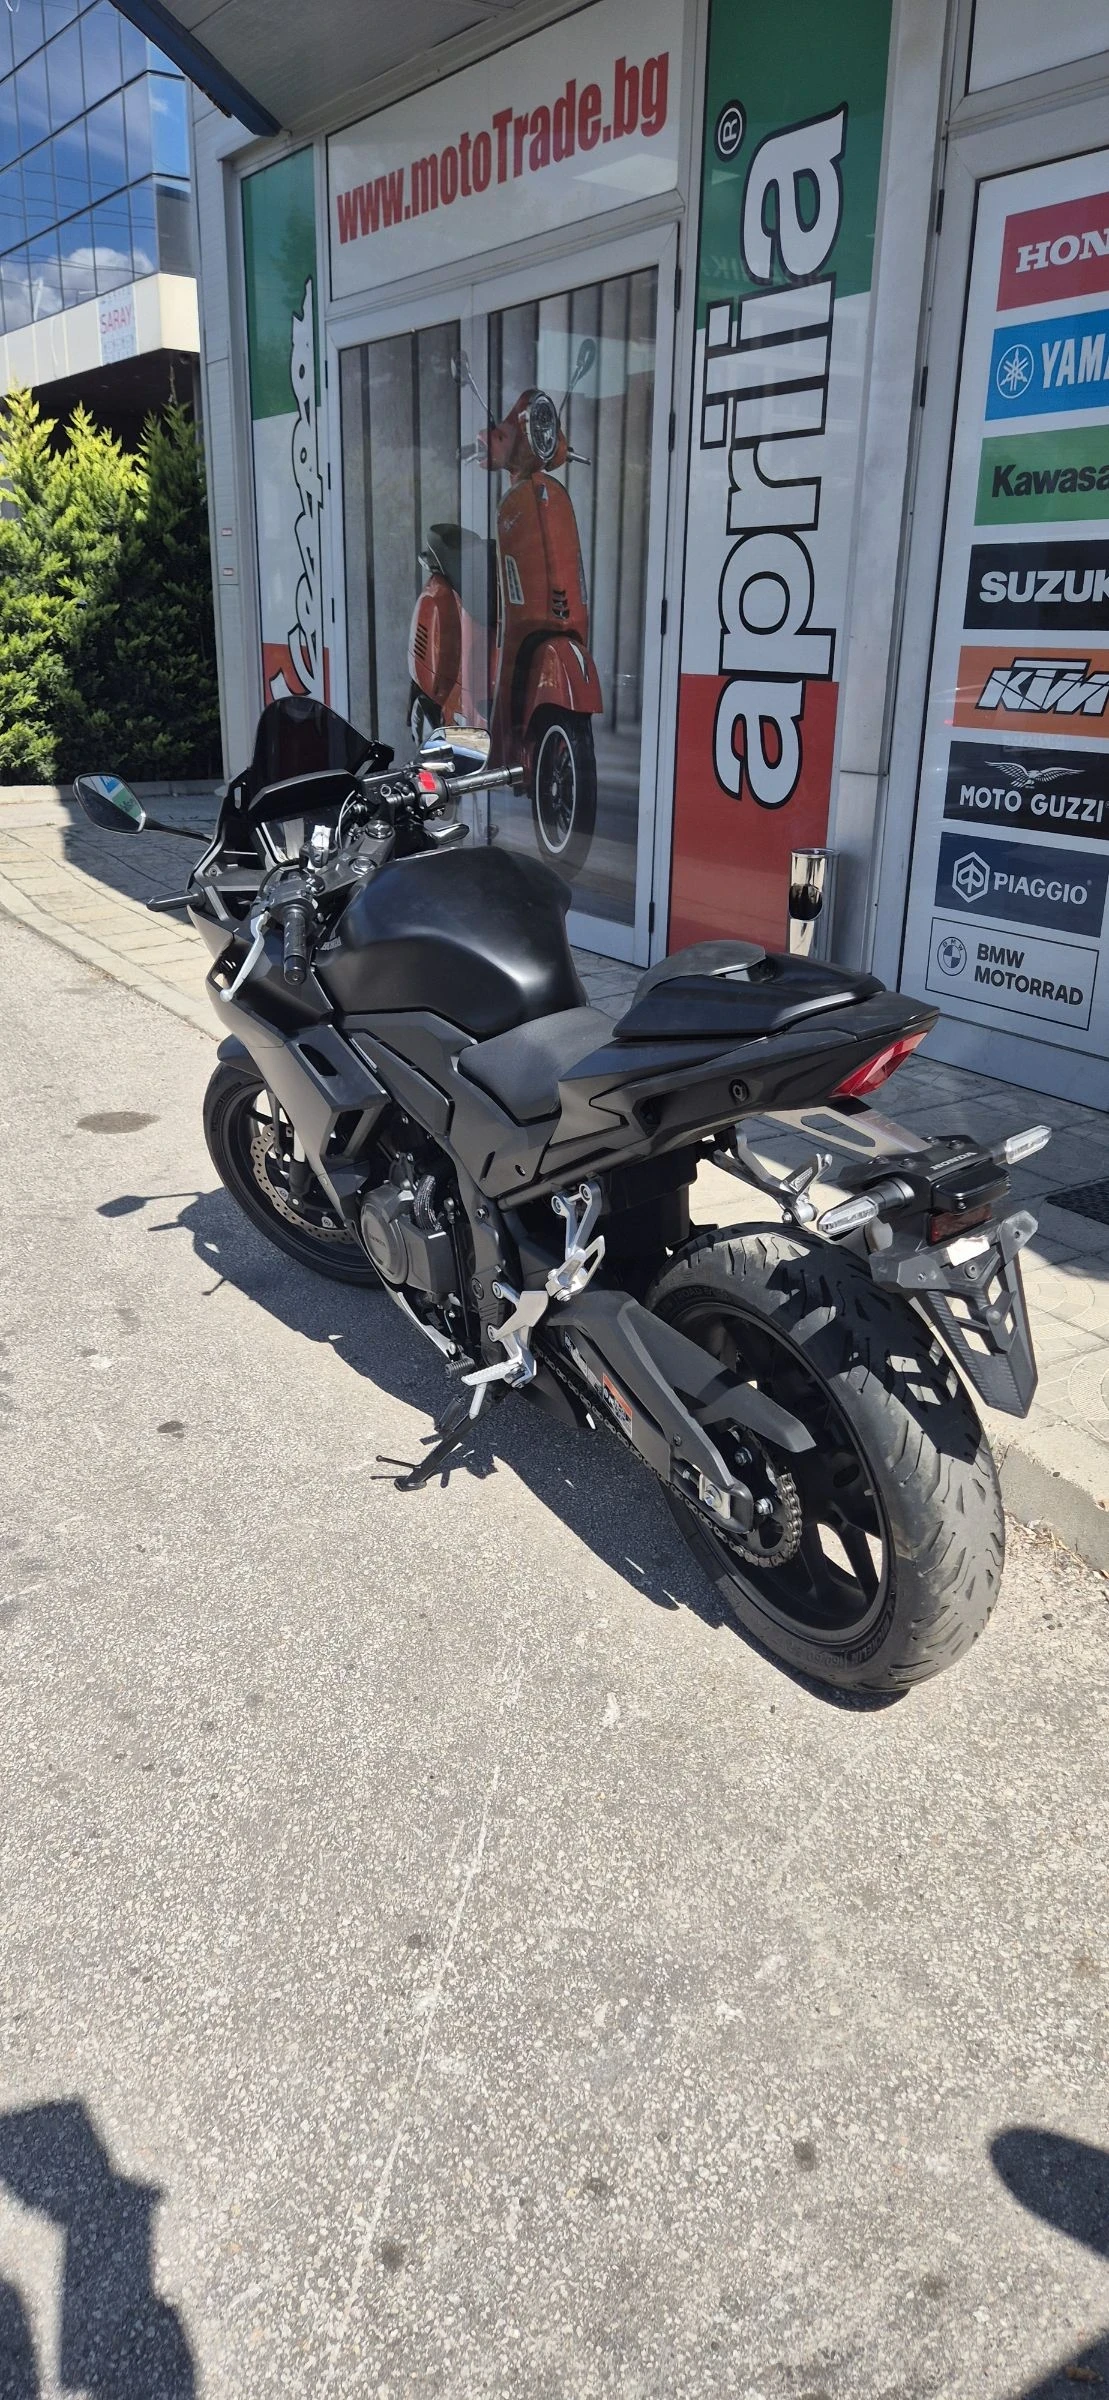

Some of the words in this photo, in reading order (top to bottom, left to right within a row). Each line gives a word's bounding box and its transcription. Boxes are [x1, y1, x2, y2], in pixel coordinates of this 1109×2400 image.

[337, 52, 669, 245] www.motoTrade.bg
[700, 102, 848, 810] aprilia
[975, 657, 1109, 716] KTM
[959, 784, 1022, 813] MOTO
[1030, 793, 1104, 823] GUZZI
[994, 871, 1088, 905] PIAGGIO
[977, 943, 1025, 969] BMW
[974, 965, 1084, 1006] MOTORRAD
[930, 1152, 978, 1170] HONDA
